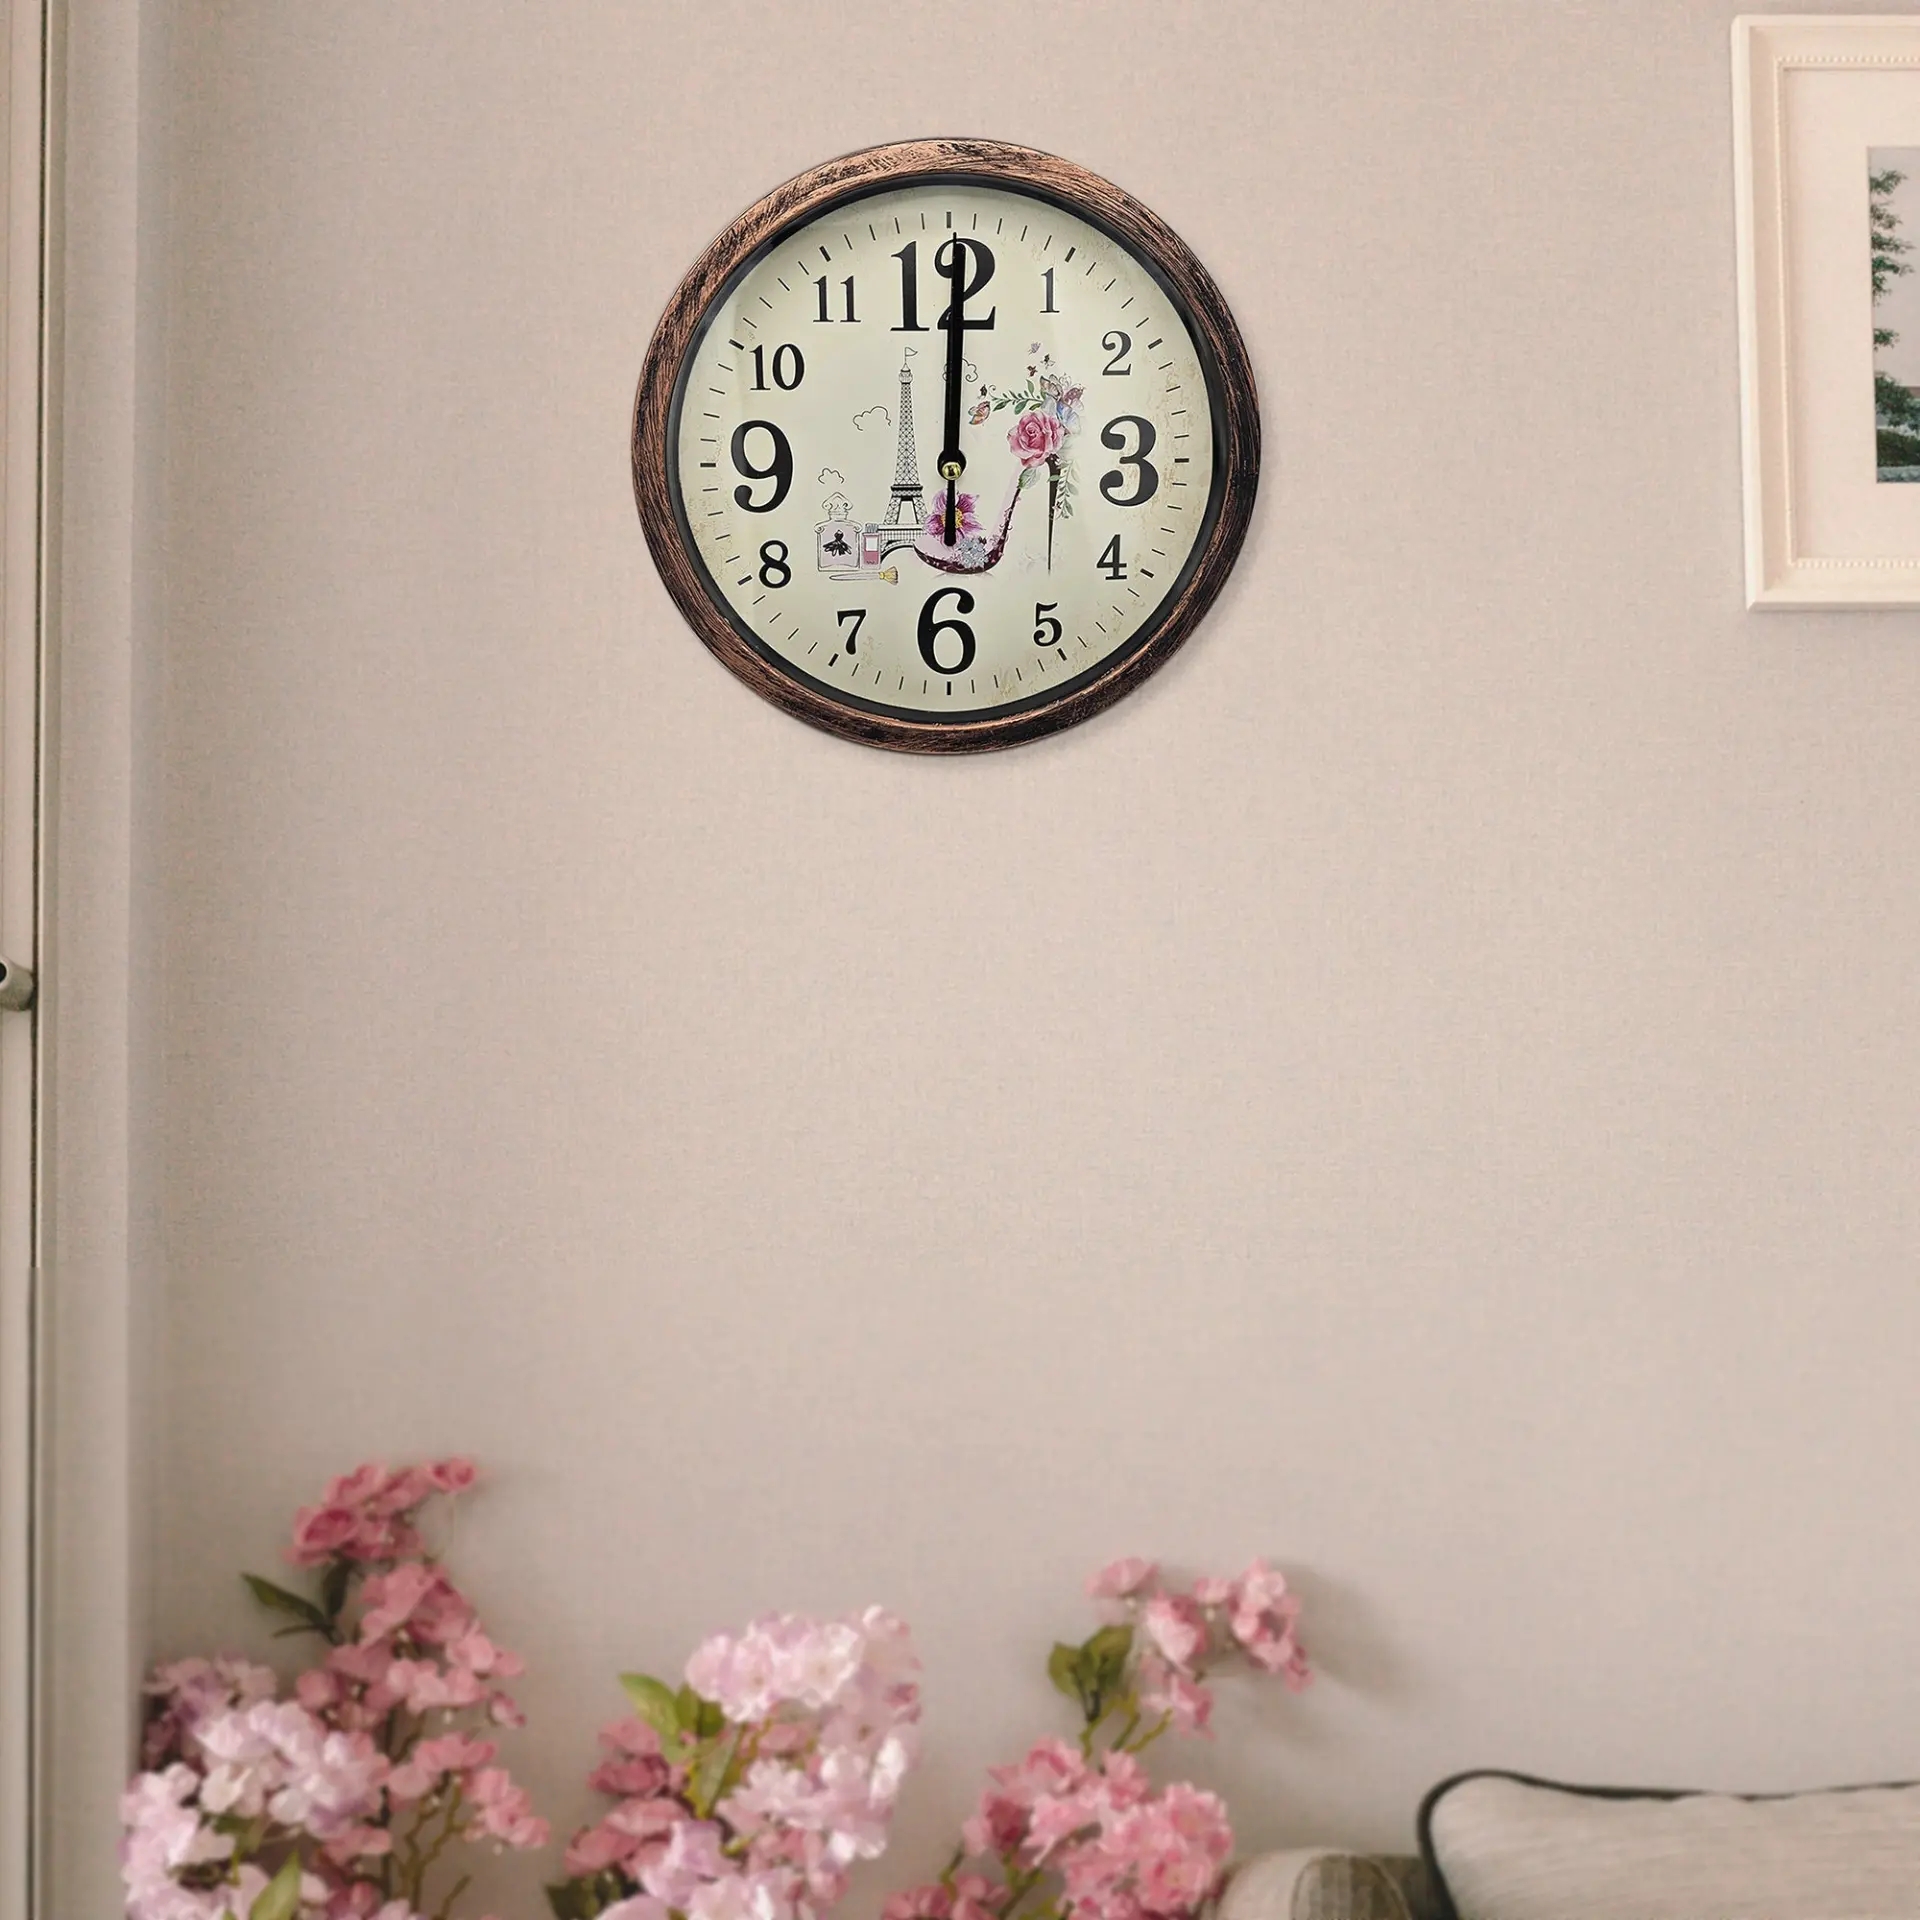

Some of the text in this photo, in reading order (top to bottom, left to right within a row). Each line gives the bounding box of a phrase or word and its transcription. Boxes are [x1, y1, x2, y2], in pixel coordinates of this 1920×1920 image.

[812, 275, 862, 323] 11
[889, 238, 996, 333] 12
[1039, 268, 1061, 314] 1
[749, 343, 805, 391] 10
[1101, 330, 1132, 376] 2
[730, 419, 794, 514] 9
[1099, 415, 1159, 507] 3
[758, 539, 792, 589] 8
[1096, 534, 1128, 581] 4
[836, 608, 867, 656] 7
[916, 586, 976, 675] 6
[1033, 602, 1063, 647] 5
